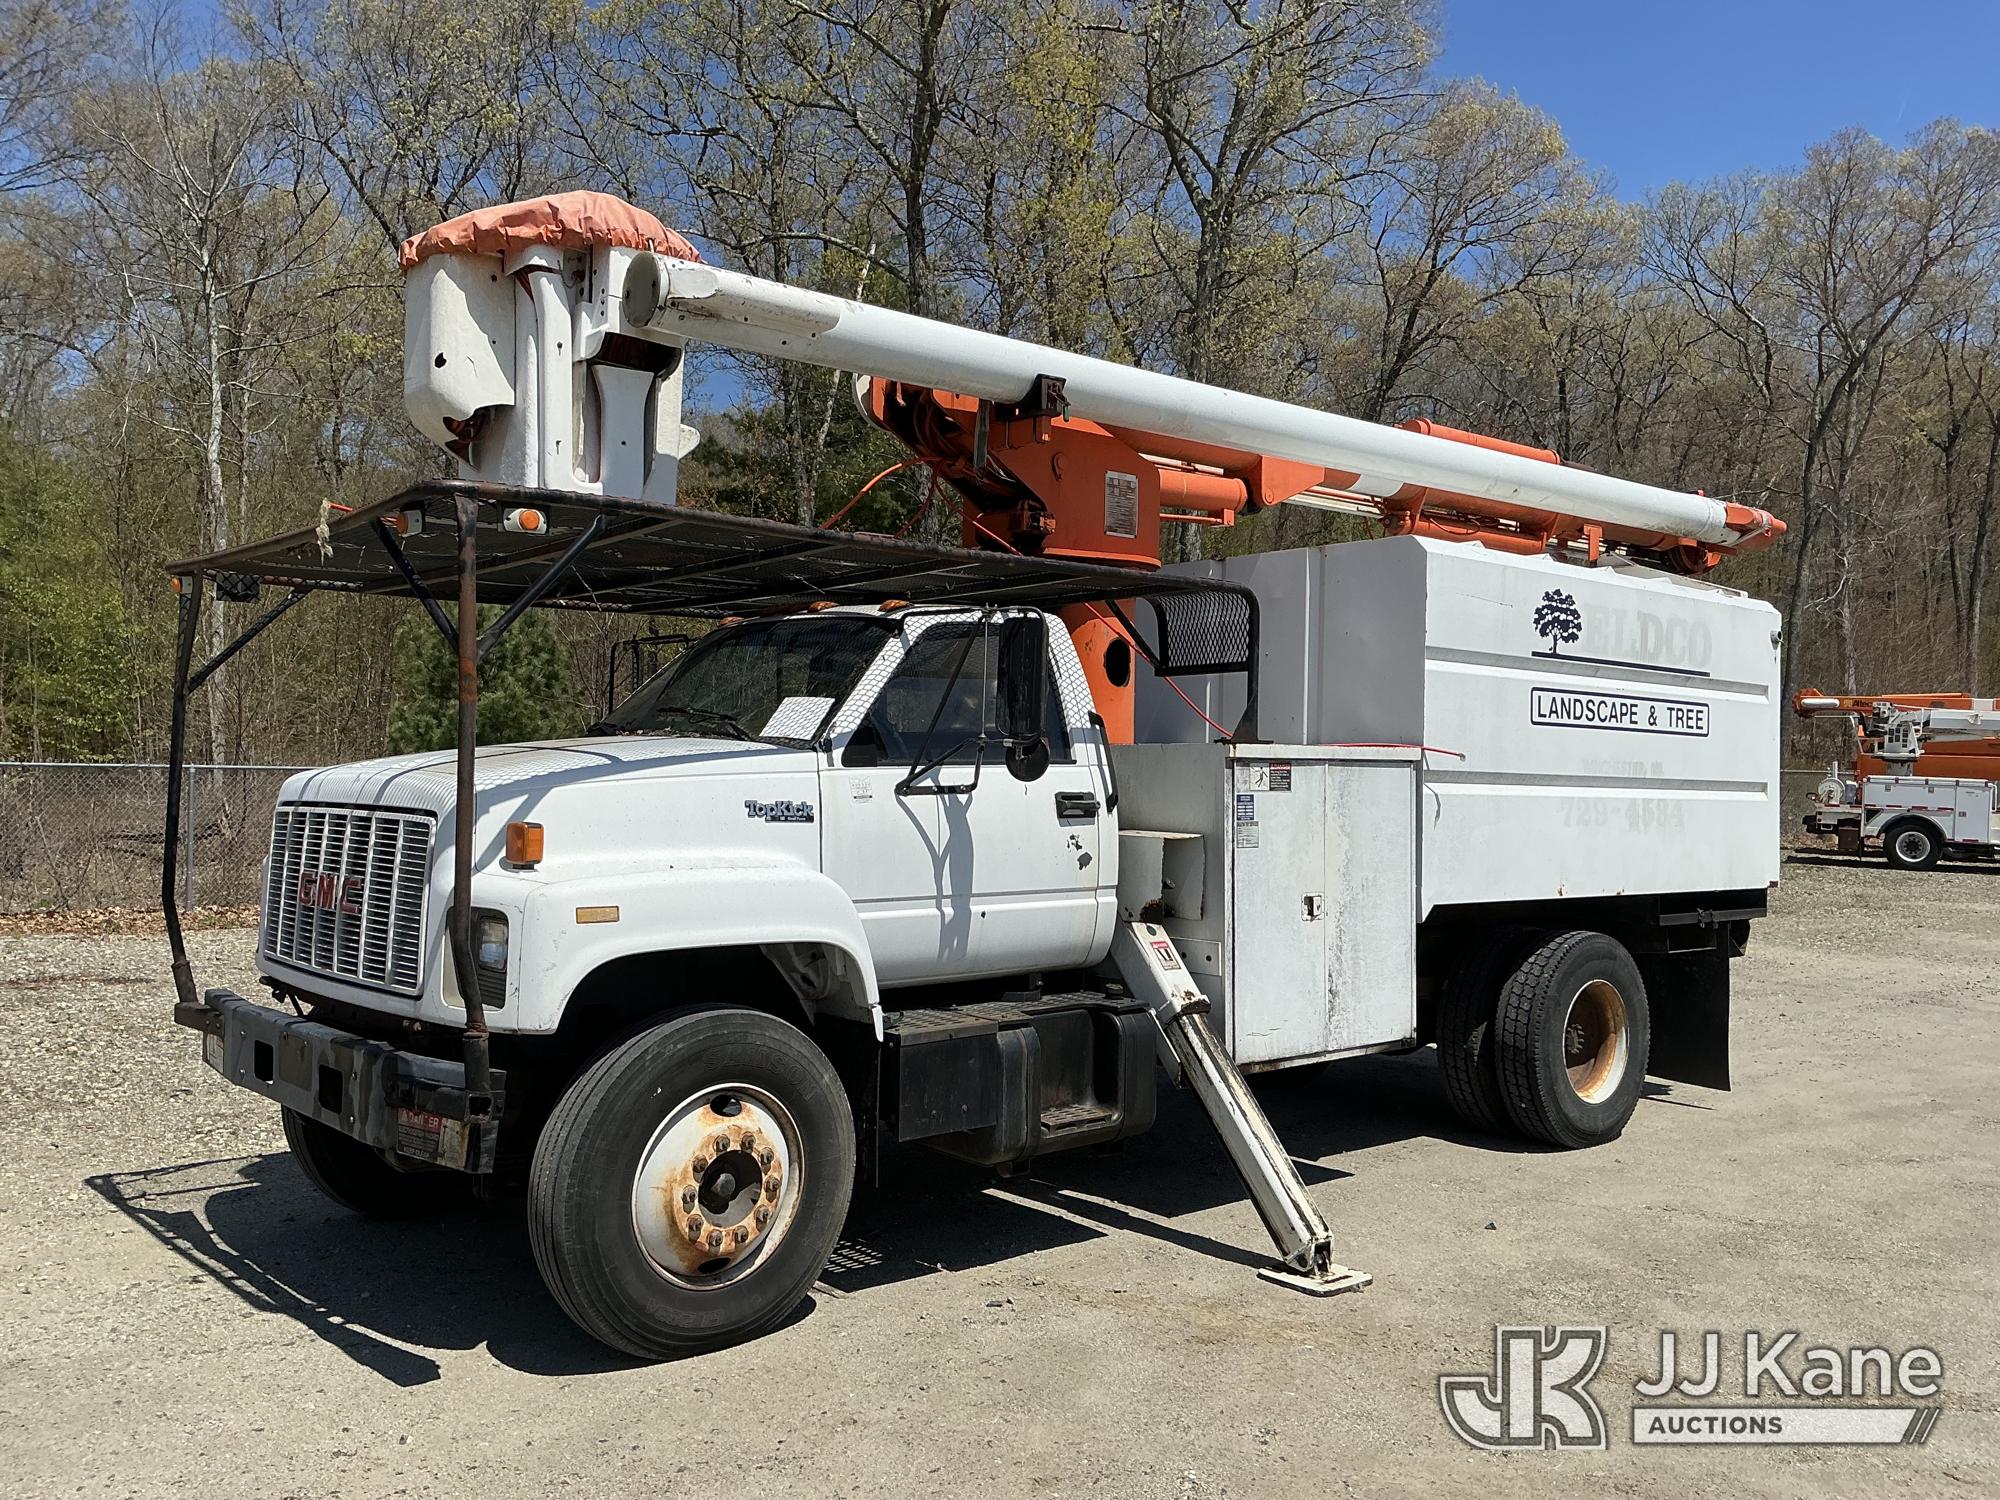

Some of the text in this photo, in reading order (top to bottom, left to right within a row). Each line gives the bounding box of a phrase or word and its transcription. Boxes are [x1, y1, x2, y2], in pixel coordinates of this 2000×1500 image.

[1537, 695, 1704, 730] LANDSCAPE & TREE
[745, 799, 814, 818] TopKick
[300, 871, 363, 914] GMC
